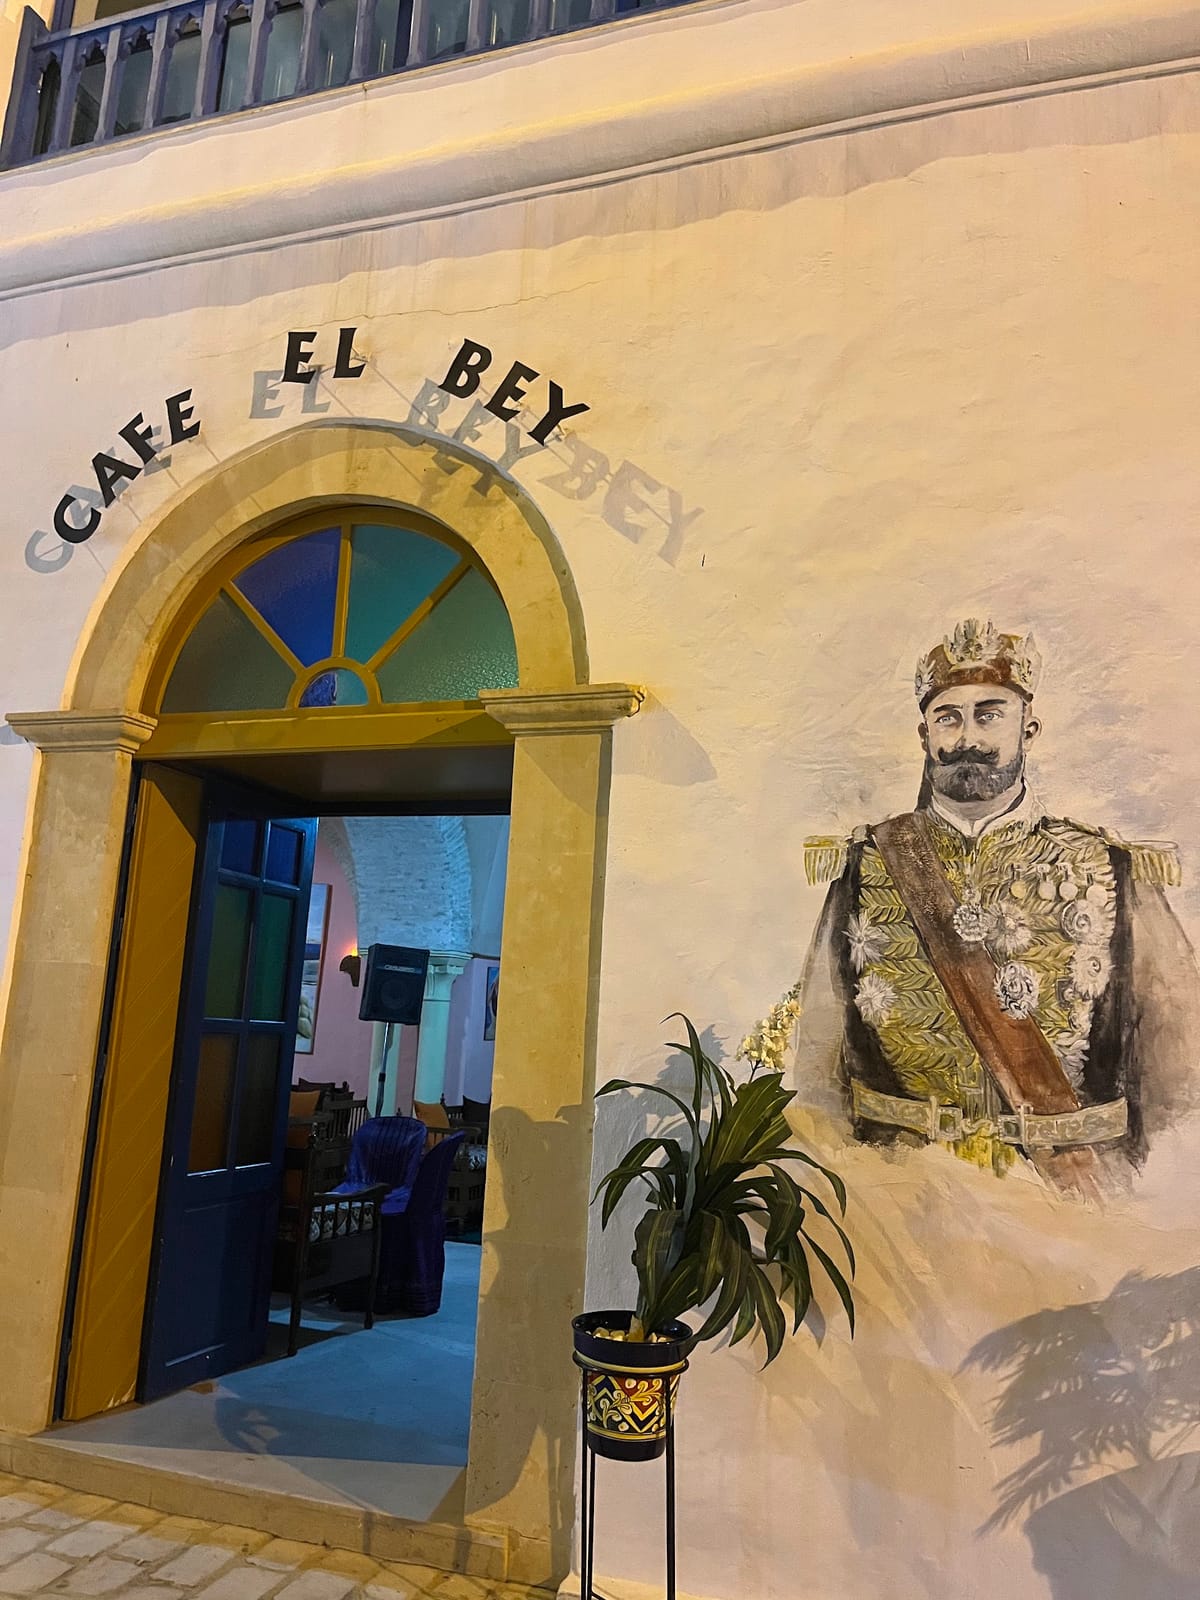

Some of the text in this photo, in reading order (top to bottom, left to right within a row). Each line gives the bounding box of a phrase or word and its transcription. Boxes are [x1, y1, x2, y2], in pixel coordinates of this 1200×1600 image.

[53, 327, 591, 544] CAFE EL BEY
